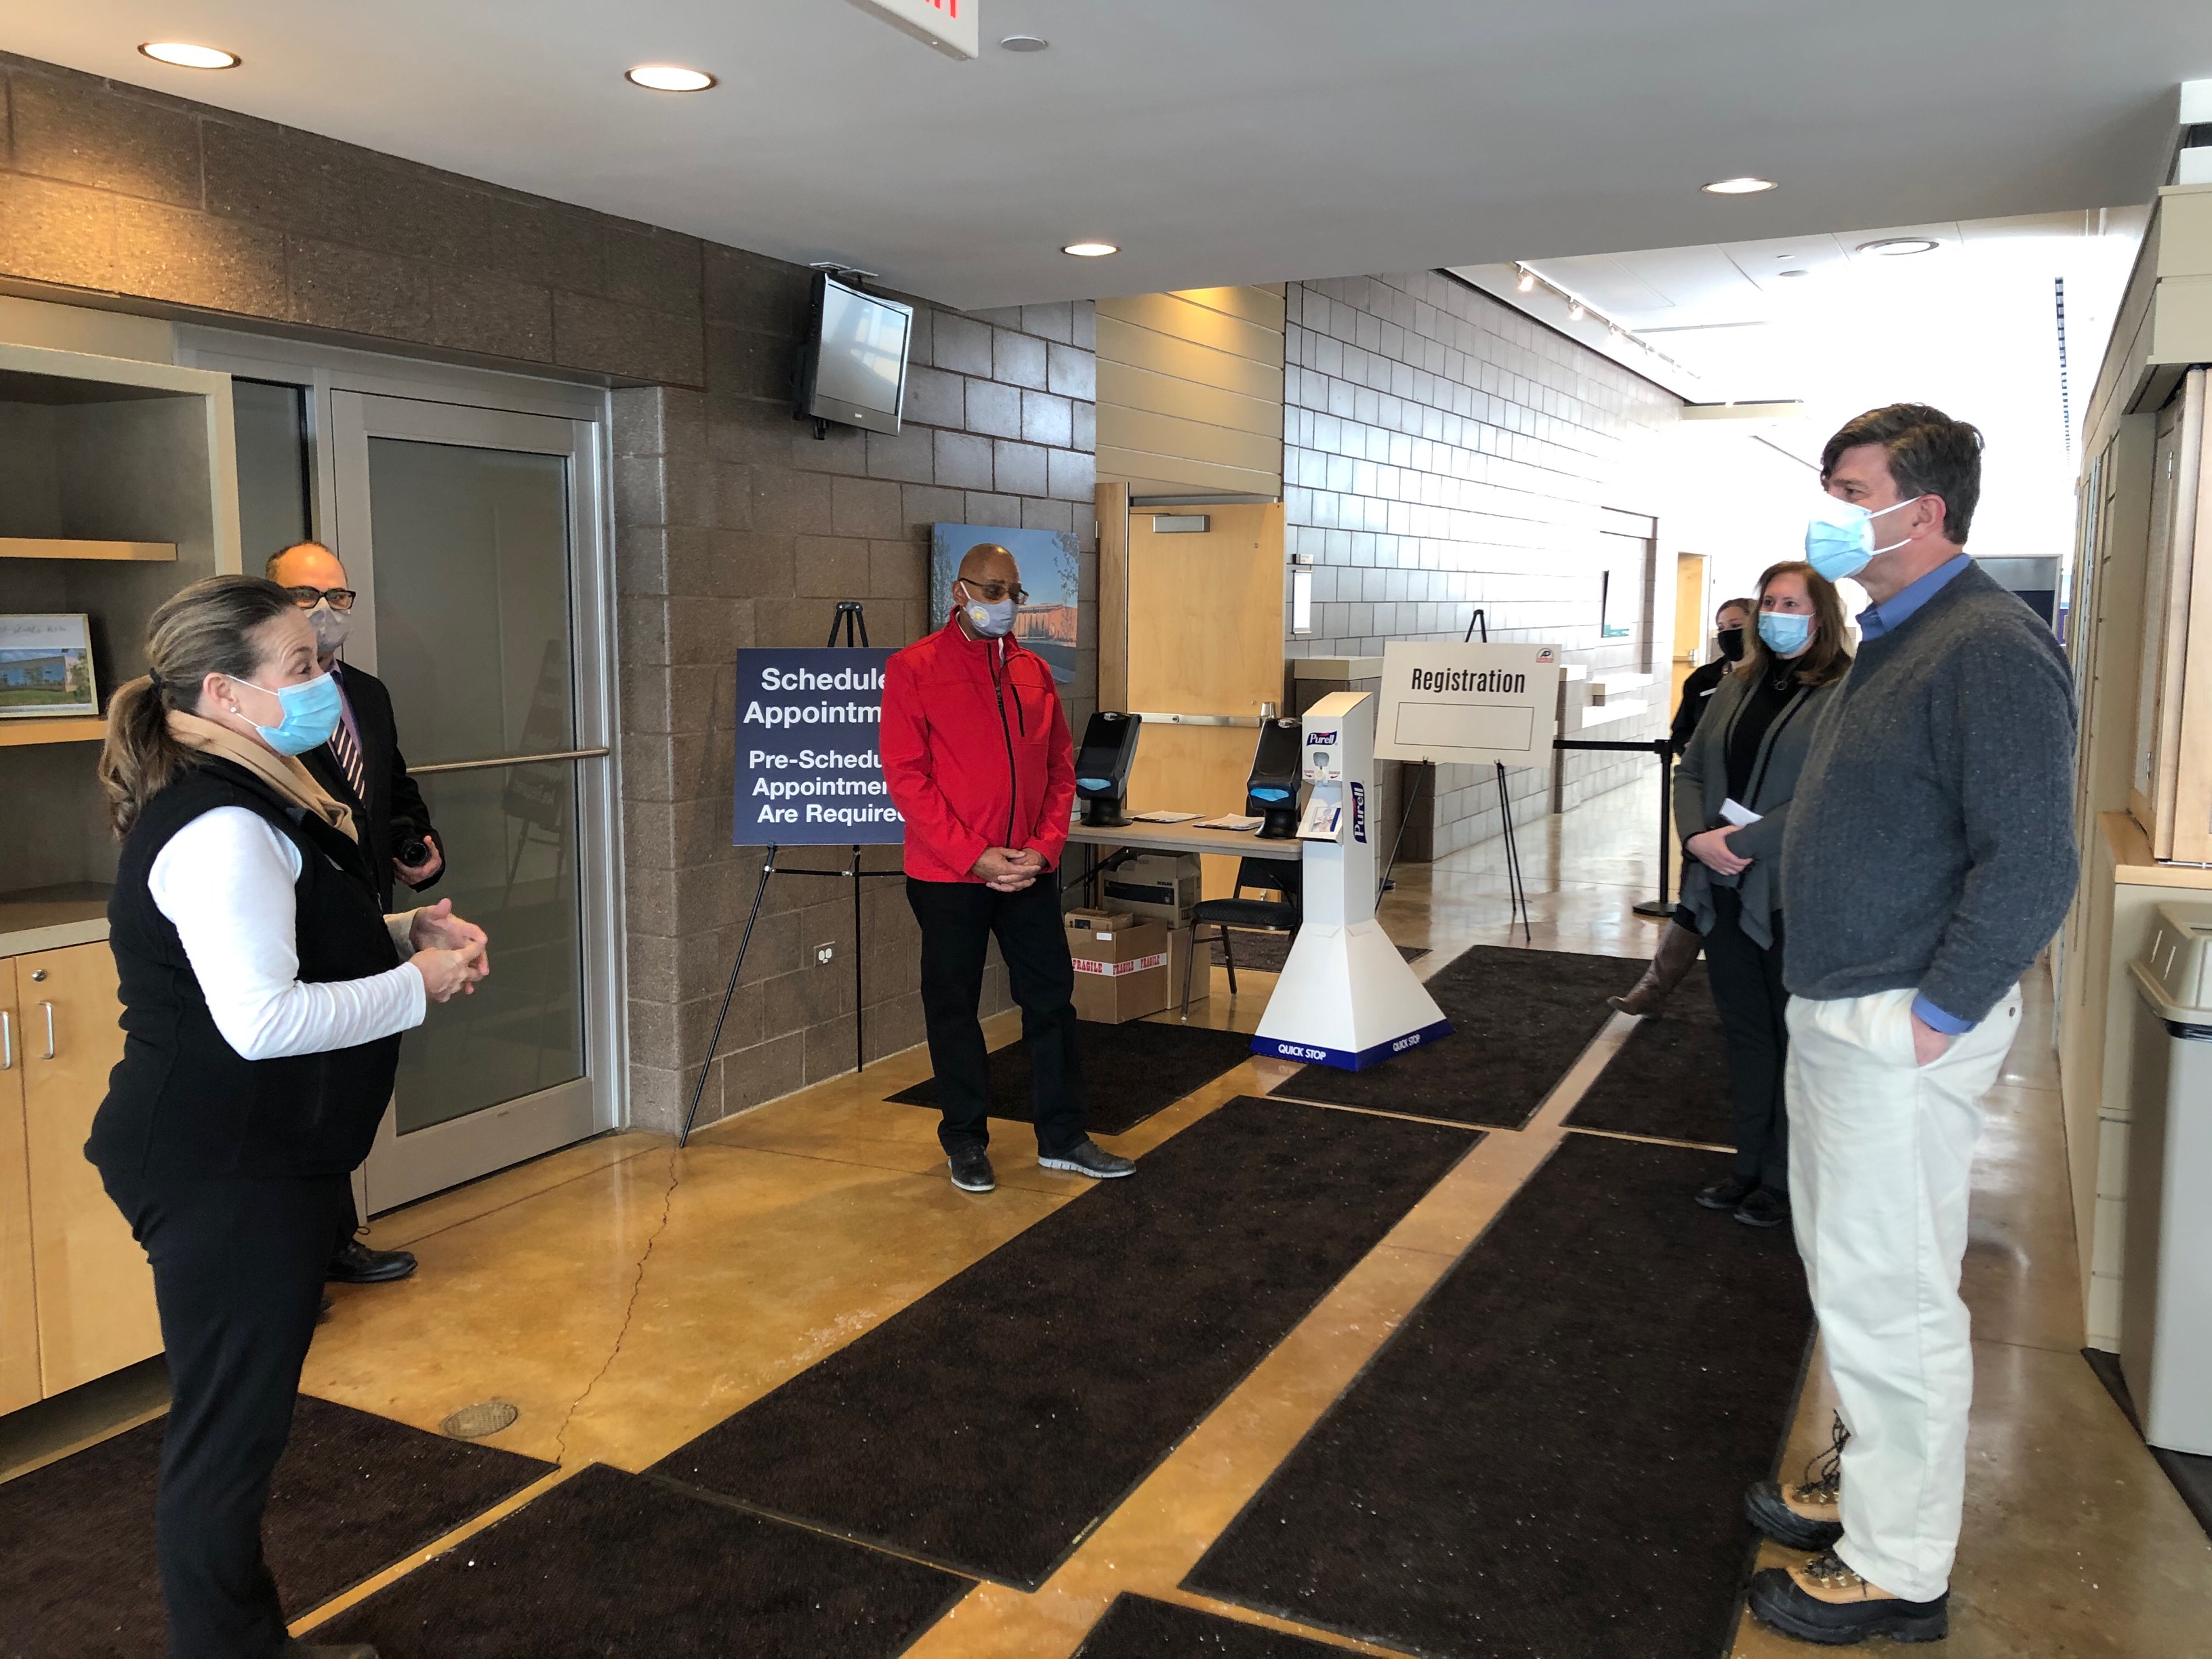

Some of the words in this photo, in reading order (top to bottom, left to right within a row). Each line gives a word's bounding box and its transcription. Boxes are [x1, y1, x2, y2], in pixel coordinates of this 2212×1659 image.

[1411, 668, 1525, 693] Registration
[743, 701, 881, 729] Appointm
[1309, 733, 1334, 744] Purell
[757, 804, 798, 823] Are
[806, 804, 905, 827] Require
[1354, 787, 1364, 836] Purell
[1072, 959, 1103, 973] FRAGILE
[1113, 961, 1134, 975] FRAGILE
[1141, 955, 1160, 969] FRAGILE
[1393, 1038, 1409, 1052] QUICK
[1408, 1033, 1420, 1046] STOP
[1277, 1044, 1304, 1057] QUICK
[1305, 1048, 1326, 1061] STOP
